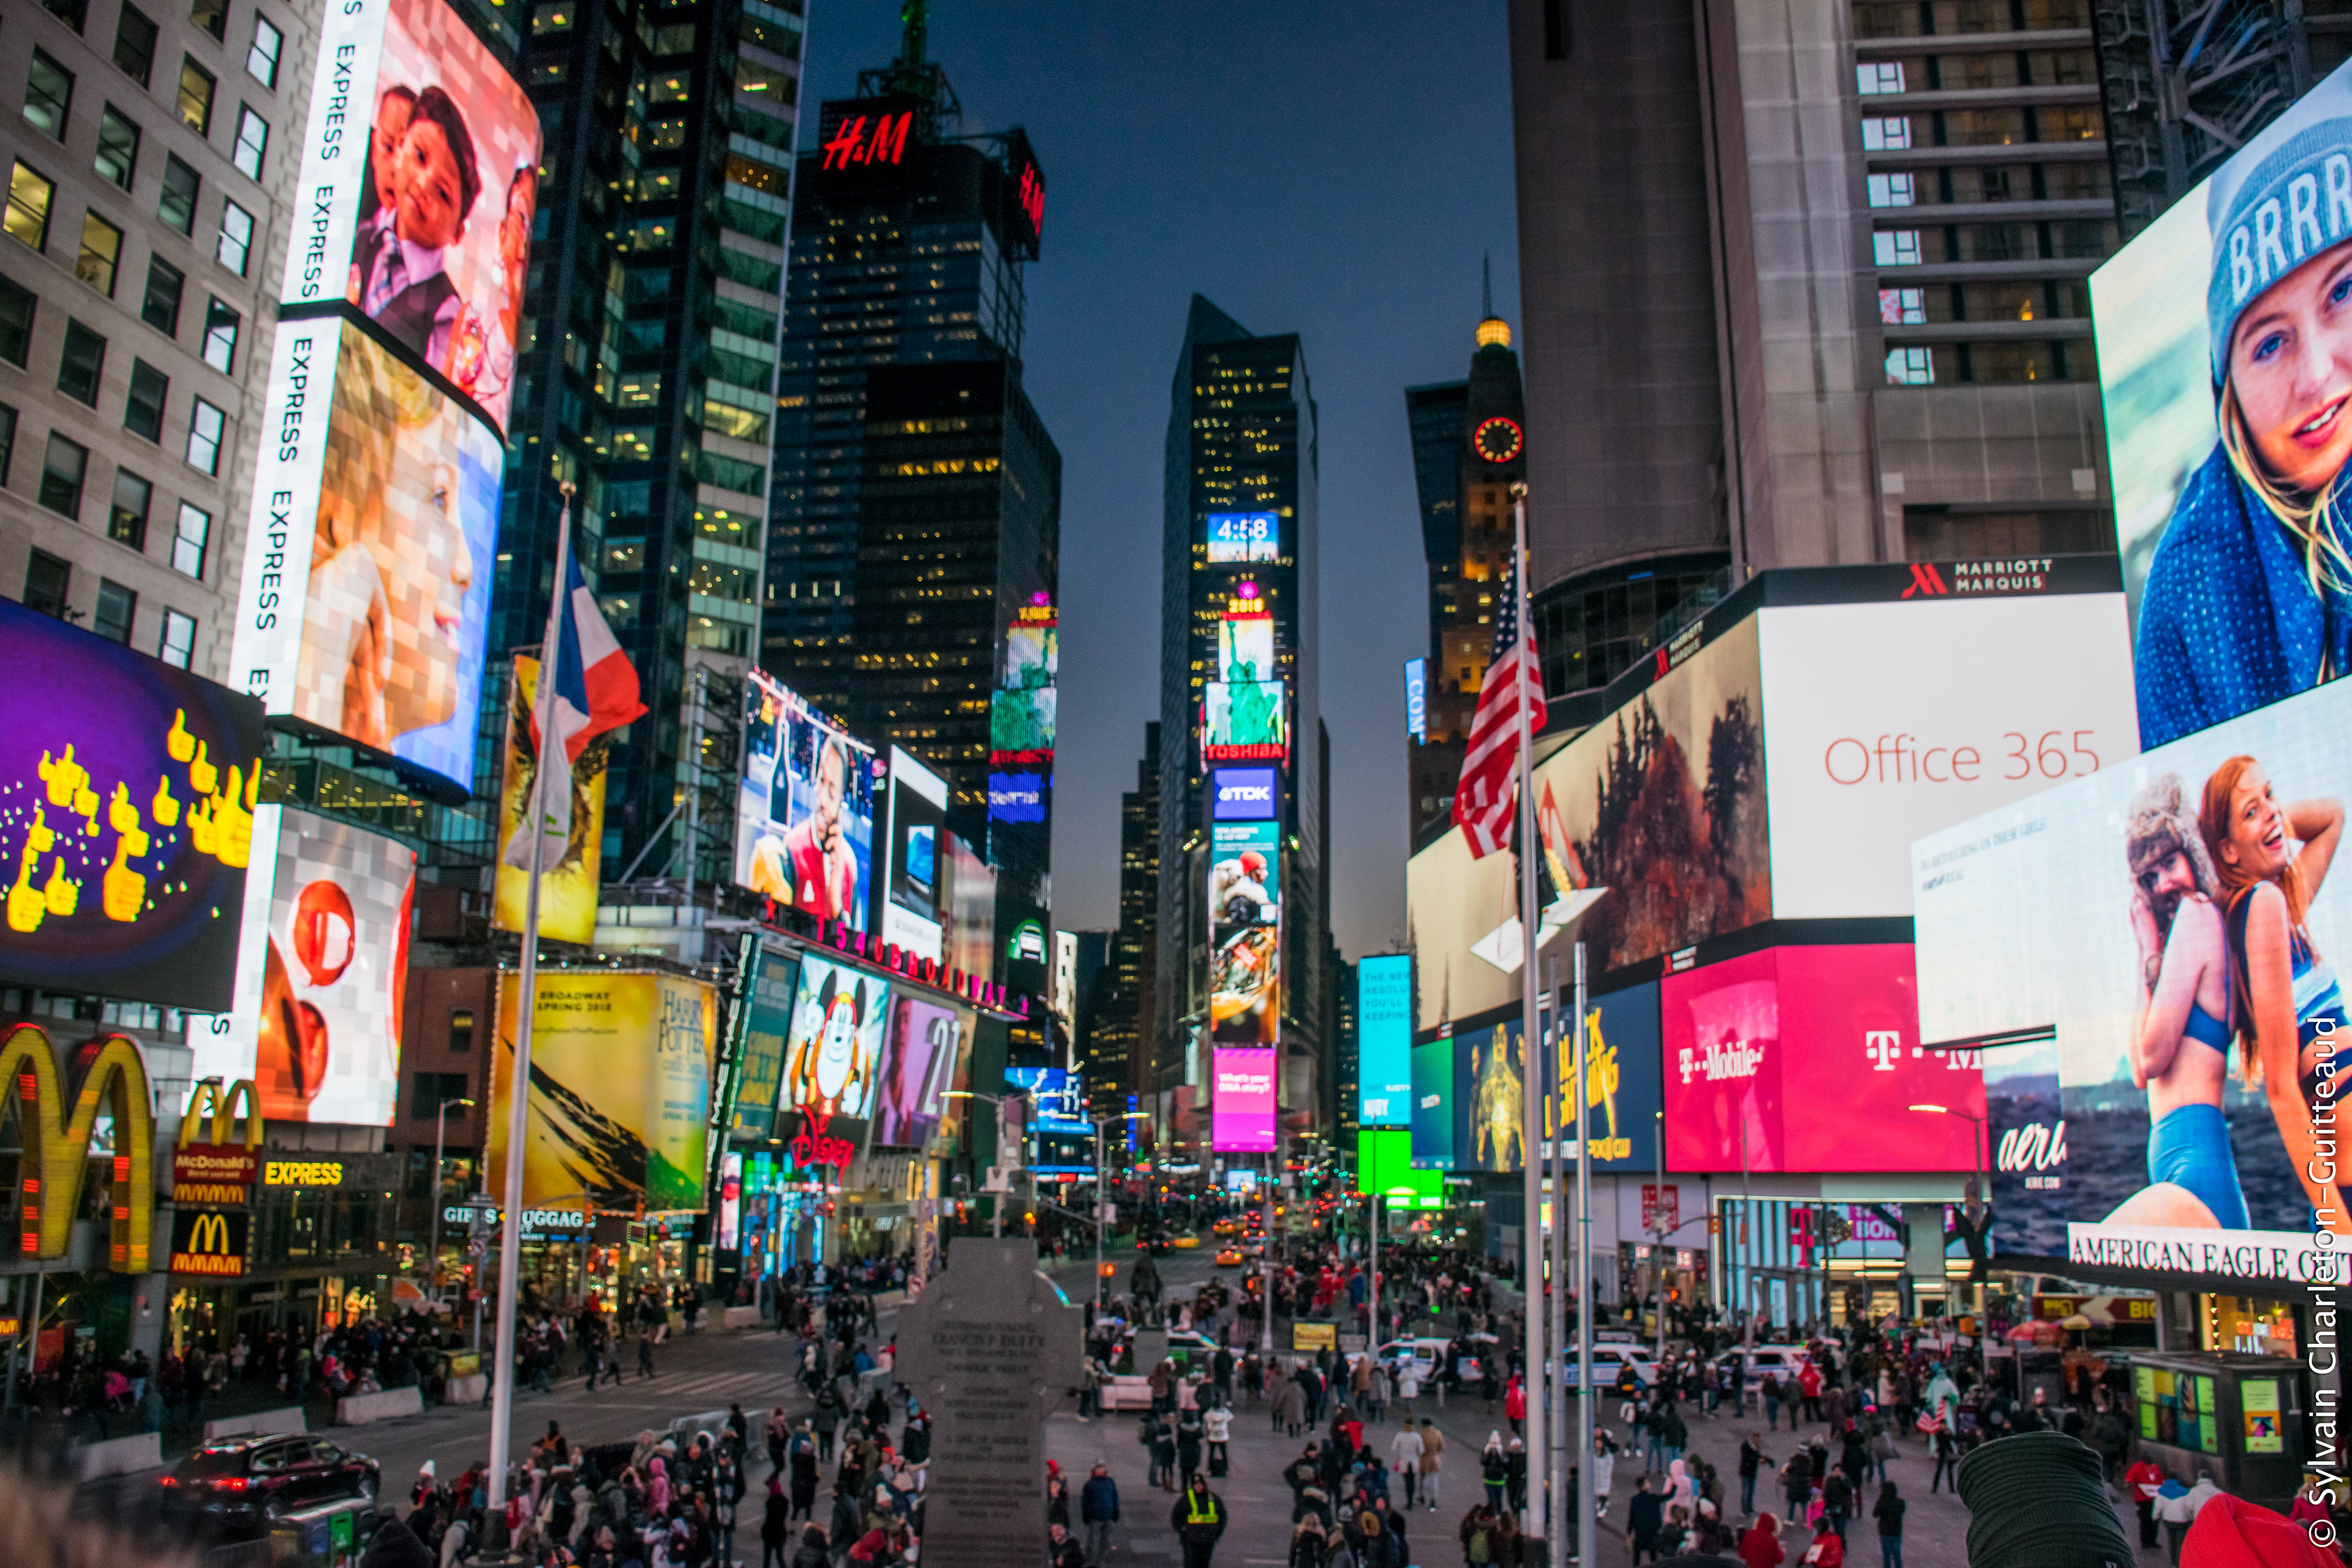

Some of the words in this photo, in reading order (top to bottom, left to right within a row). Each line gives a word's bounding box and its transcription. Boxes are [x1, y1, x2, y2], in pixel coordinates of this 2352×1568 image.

[321, 44, 356, 160] EXPRESS
[823, 111, 913, 171] H&M
[301, 185, 334, 298] EXPRESS
[279, 337, 313, 462] EXPRESS
[1217, 518, 1268, 540] 4:58
[255, 491, 292, 630] EXPRESS
[1954, 559, 2052, 576] MARRIOTT
[1956, 575, 2043, 592] MARQUIS
[1228, 597, 1265, 614] 2018
[1668, 619, 1703, 654] MARRIOTT
[1669, 636, 1700, 668] MARQUIS
[1206, 742, 1284, 760] TOSHIBA
[1825, 733, 1981, 785] Office
[2003, 730, 2100, 780] 365
[1231, 786, 1270, 801] TDK
[1364, 973, 1385, 983] THE
[539, 990, 611, 1000] BROADWAY
[537, 1001, 581, 1012] SPRING
[1218, 1073, 1249, 1084] What's
[1249, 1074, 1270, 1087] your
[1218, 1083, 1240, 1093] DNA
[1242, 1082, 1271, 1095] story?
[791, 1104, 855, 1187] Disney
[175, 1155, 255, 1170] McDonald's
[264, 1161, 344, 1186] EXPRESS
[443, 1206, 497, 1224] GIFS
[2071, 1236, 2194, 1273] AMERICAN
[2202, 1243, 2288, 1280] EAGLE
